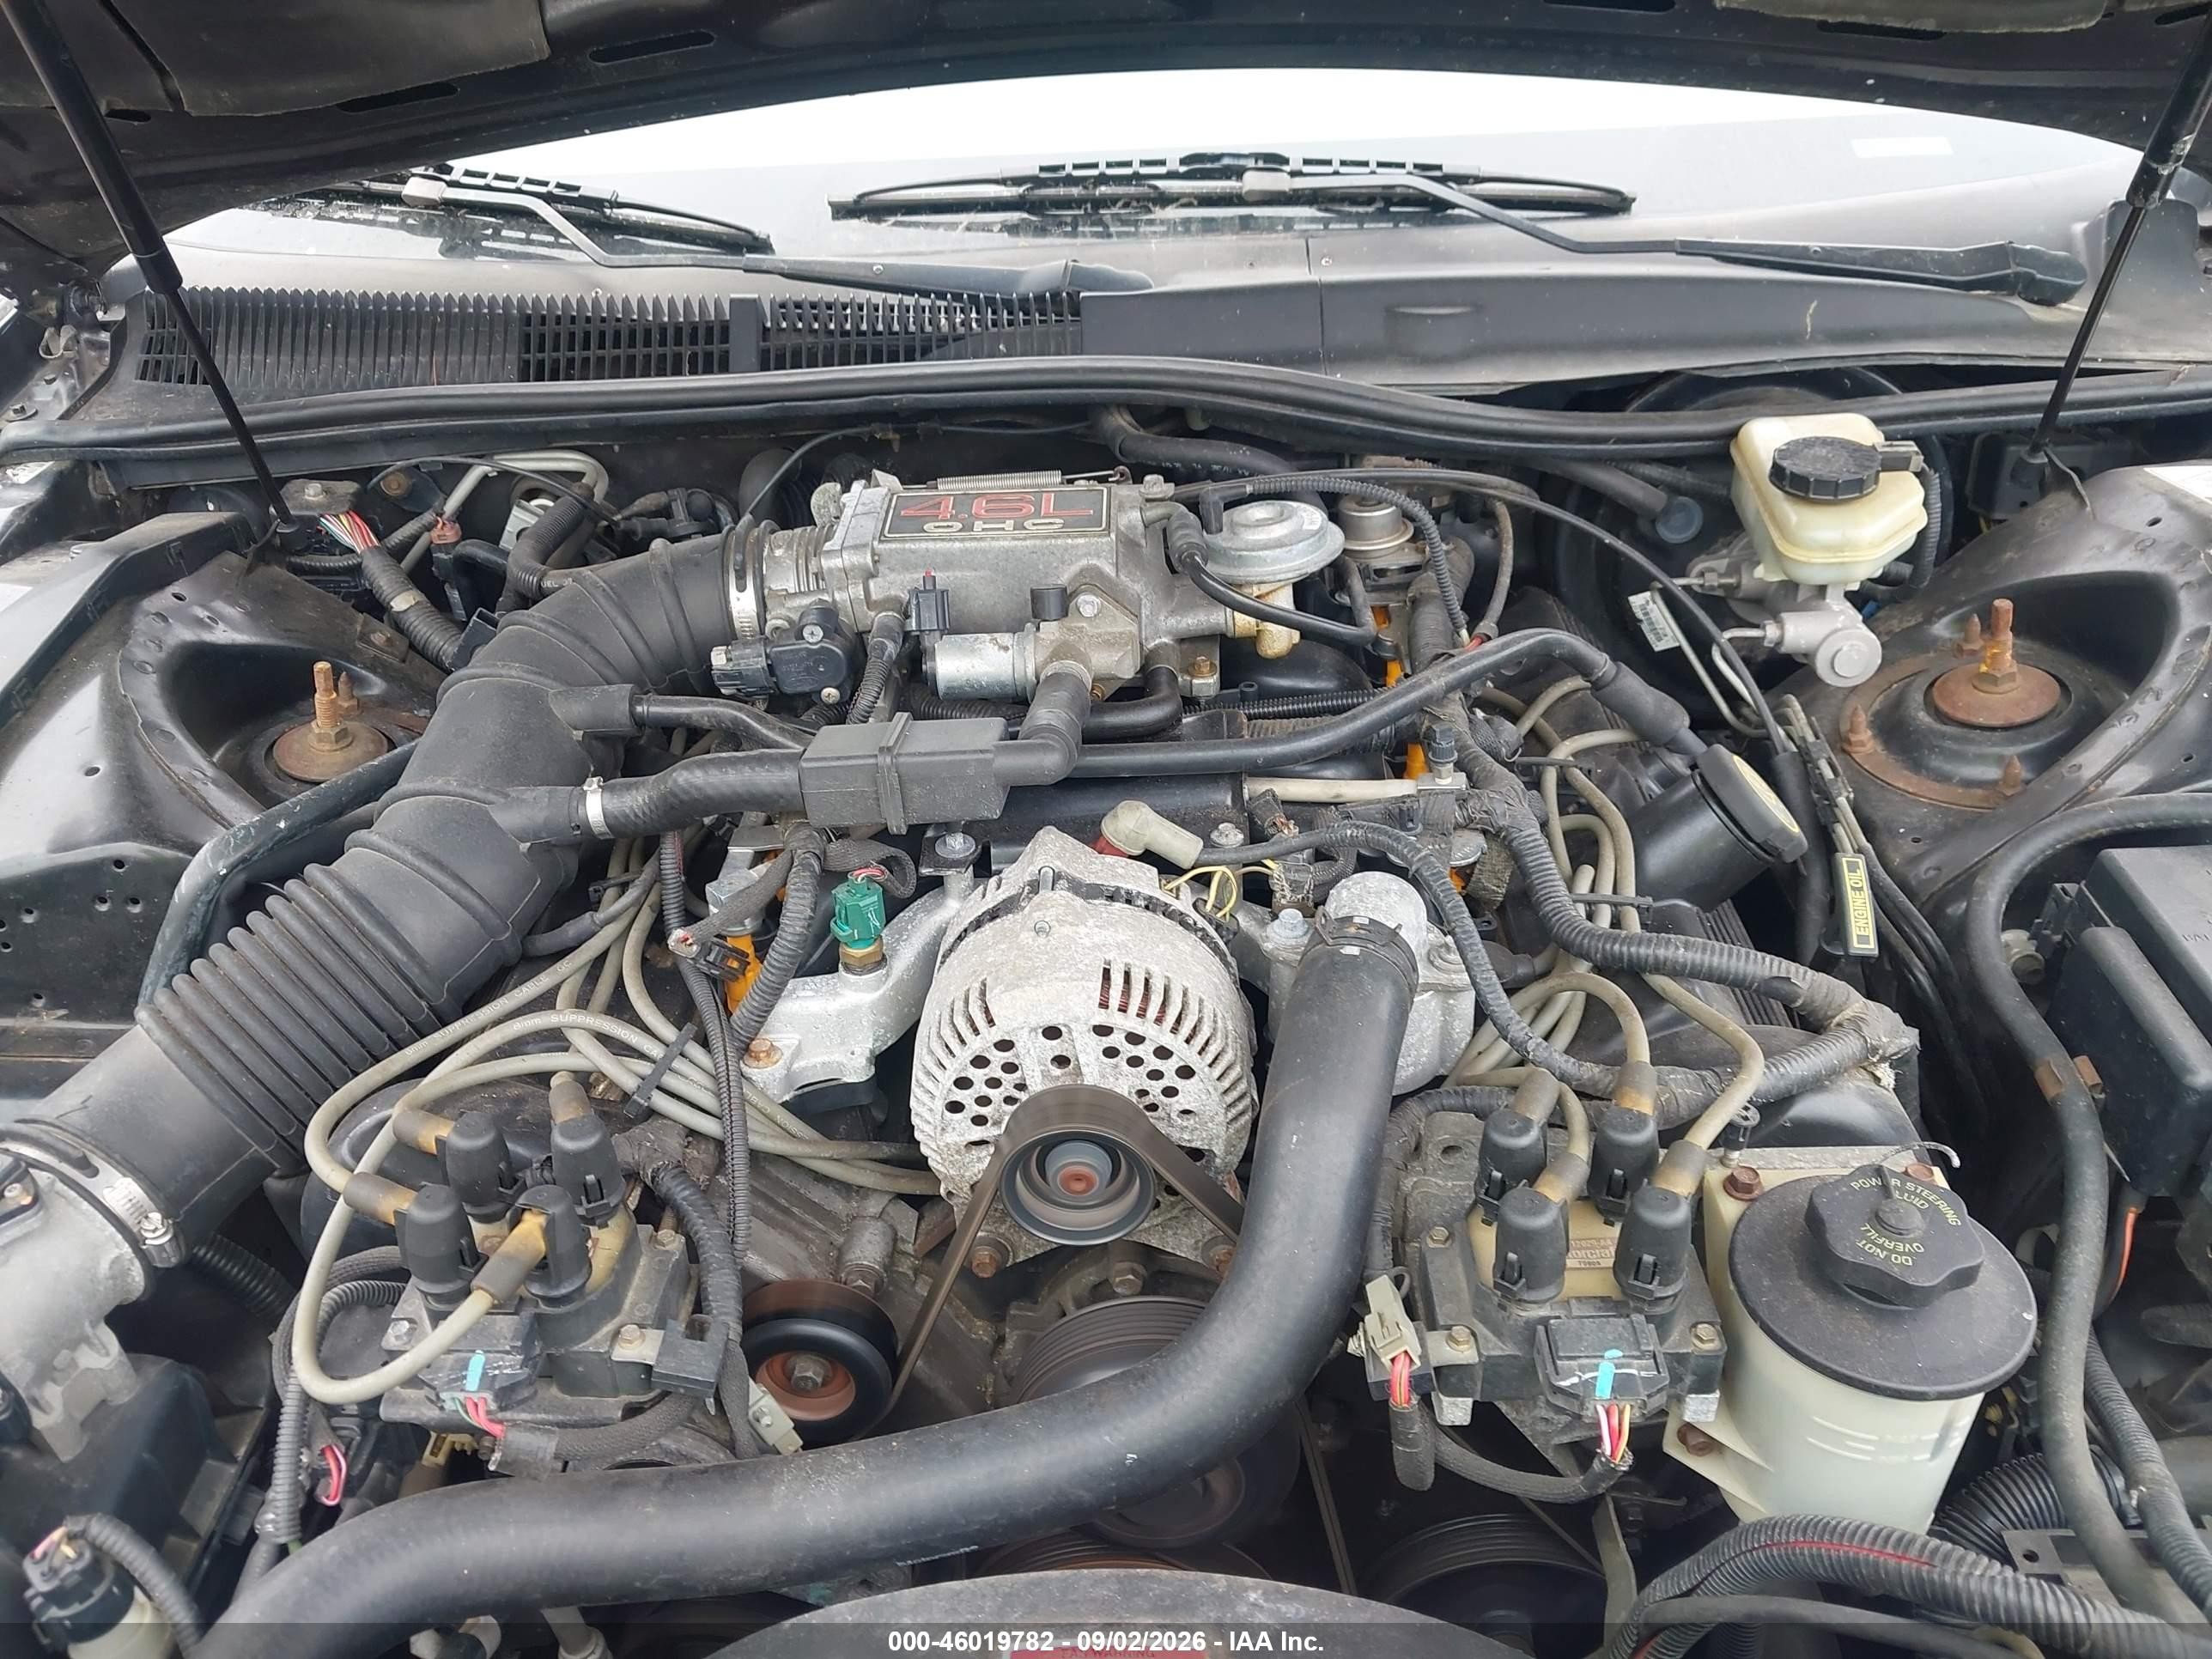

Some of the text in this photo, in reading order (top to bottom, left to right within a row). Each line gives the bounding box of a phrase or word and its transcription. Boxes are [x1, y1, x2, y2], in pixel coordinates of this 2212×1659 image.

[901, 493, 1093, 520] 4.6L
[922, 518, 1065, 532] OHC
[540, 580, 559, 588] UEL
[1848, 867, 1870, 936] ENGINE OIL
[514, 1017, 542, 1030] 8mm
[550, 1013, 638, 1043] SUPPRESSION
[1850, 1176, 1962, 1226] POWR STEERING
[1895, 1190, 1929, 1209] LUID
[1859, 1222, 1925, 1253] OVERFILL
[1855, 1239, 1913, 1266] DO NOT
